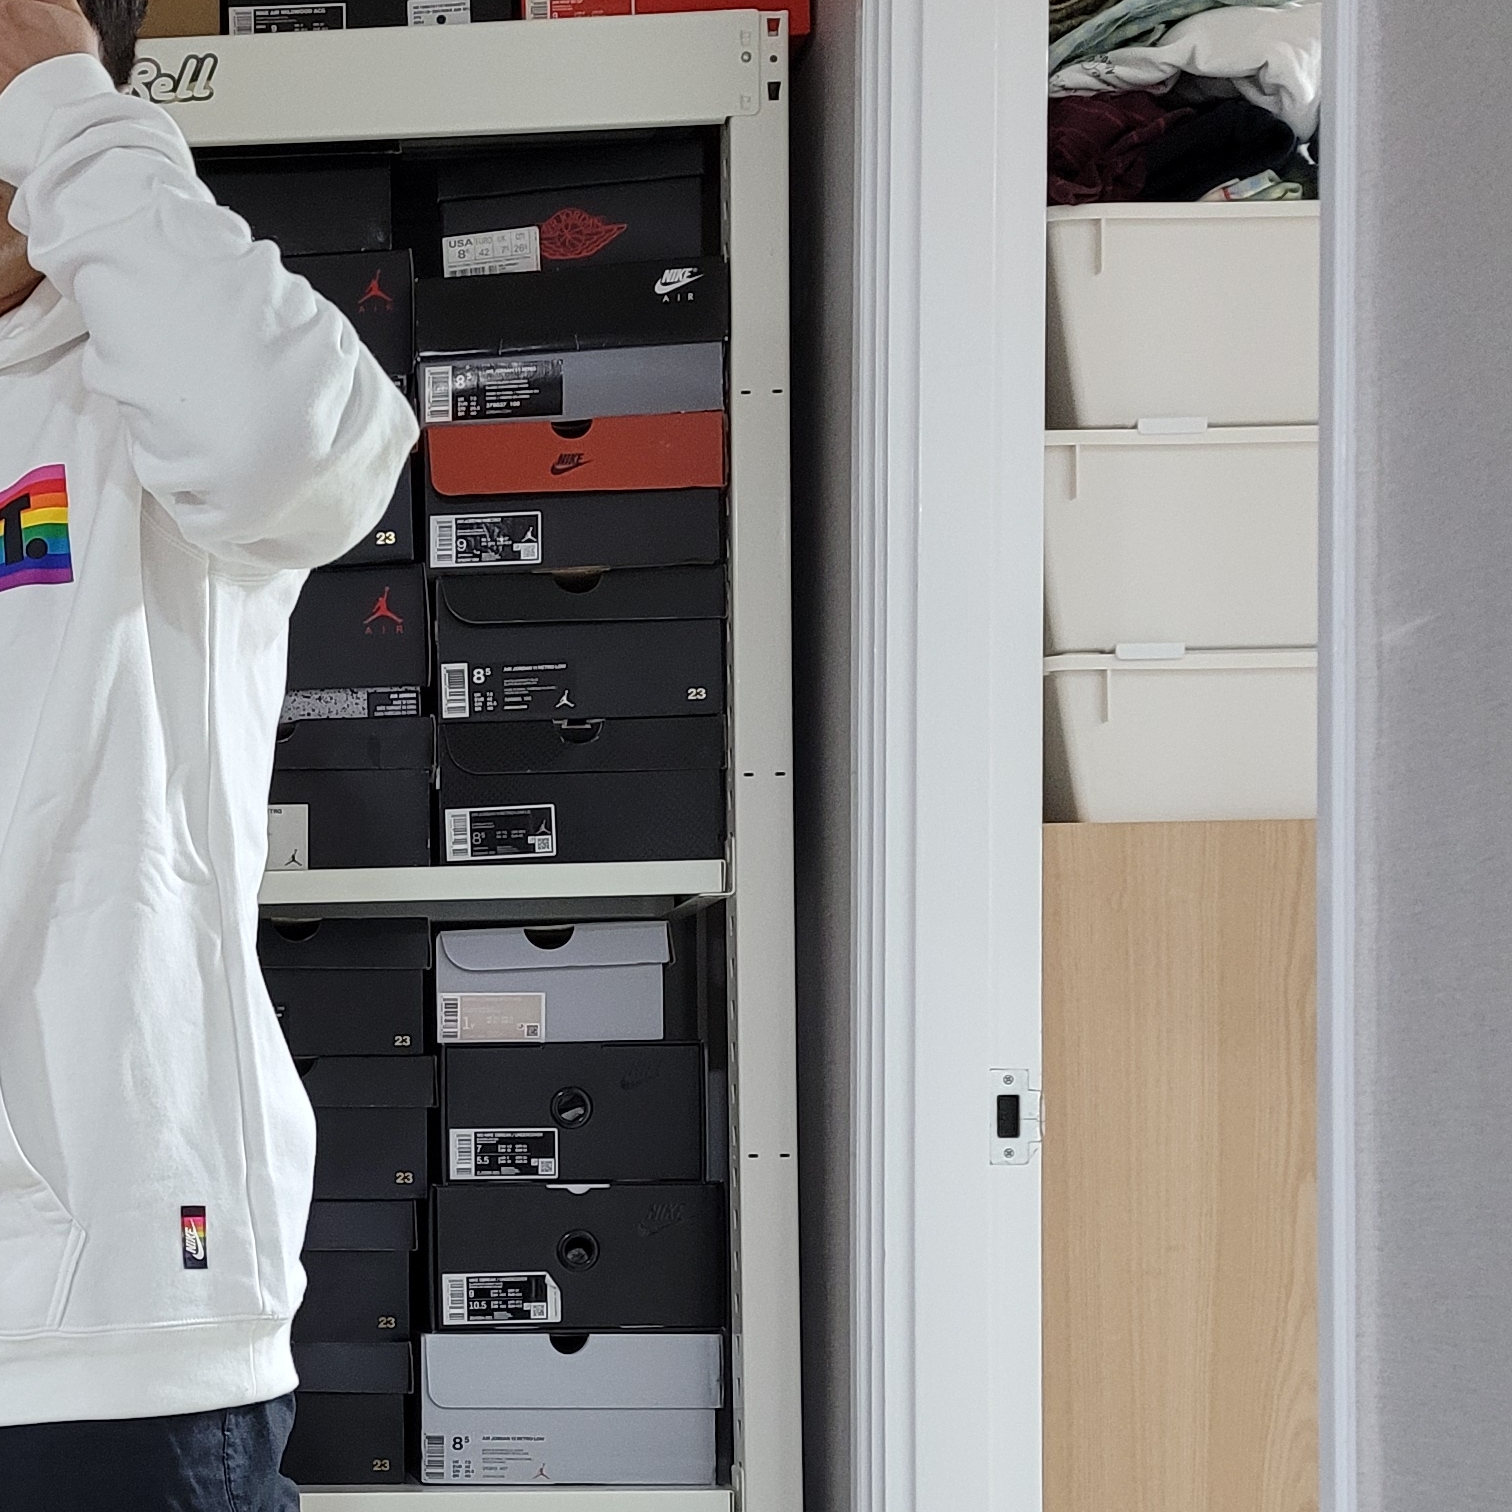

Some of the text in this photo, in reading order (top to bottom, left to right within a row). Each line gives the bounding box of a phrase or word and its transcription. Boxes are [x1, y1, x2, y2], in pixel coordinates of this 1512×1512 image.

[448, 239, 473, 248] USA
[479, 247, 490, 257] 42
[661, 267, 693, 284] NIKE
[661, 292, 694, 303] AIR
[556, 452, 585, 466] NIKE
[375, 531, 396, 545] 23
[456, 538, 467, 552] 9
[364, 625, 404, 635] AIR
[687, 687, 707, 699] 23
[394, 1035, 411, 1047] 23
[476, 1144, 482, 1153] 7
[476, 1156, 490, 1164] 5.5
[395, 1172, 413, 1184] 23
[184, 1226, 197, 1254] NIKE
[468, 1301, 487, 1310] 10.5
[378, 1316, 395, 1329] 23
[372, 1459, 390, 1472] 23
